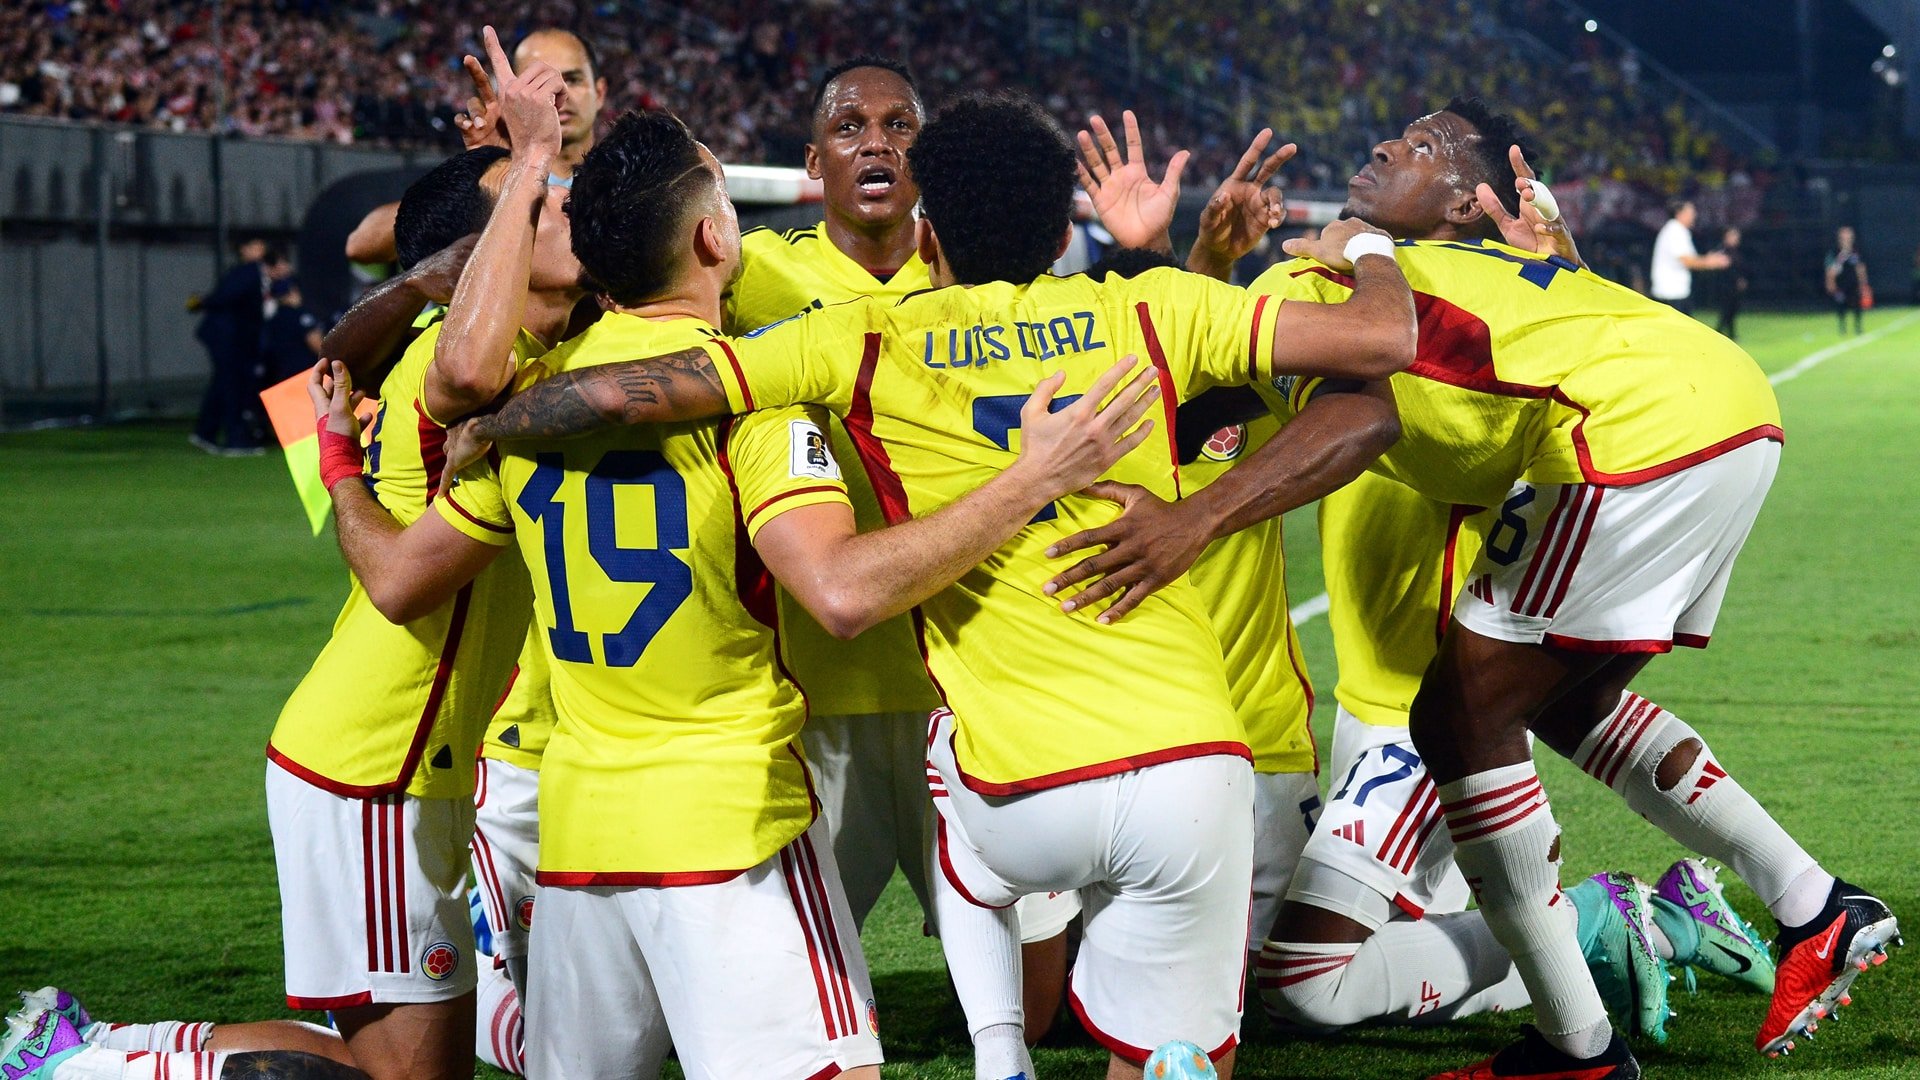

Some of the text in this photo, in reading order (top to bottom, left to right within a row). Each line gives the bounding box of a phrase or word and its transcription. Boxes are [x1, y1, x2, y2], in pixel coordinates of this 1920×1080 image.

[924, 311, 1107, 369] LUIS DIAZ
[516, 450, 693, 668] 19
[1486, 484, 1537, 567] 6
[1332, 743, 1422, 808] 17
